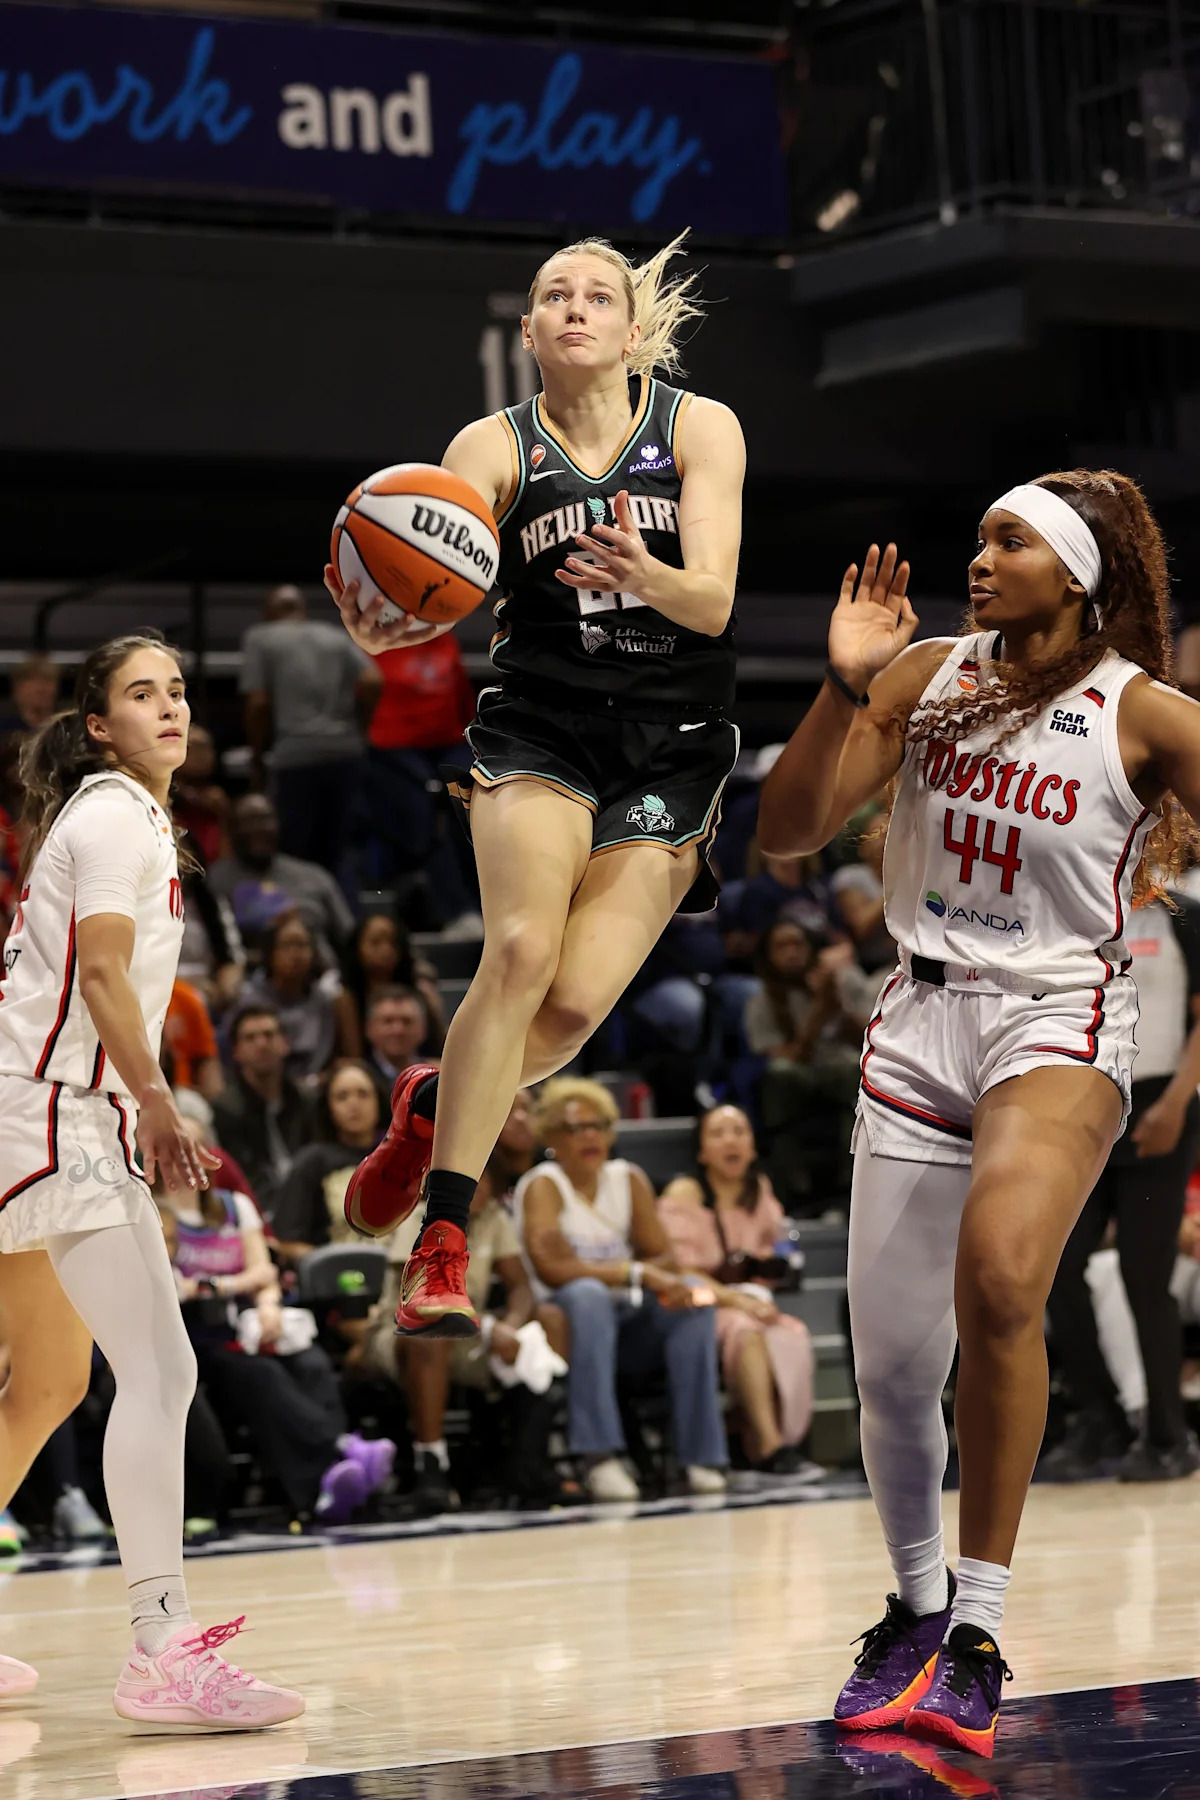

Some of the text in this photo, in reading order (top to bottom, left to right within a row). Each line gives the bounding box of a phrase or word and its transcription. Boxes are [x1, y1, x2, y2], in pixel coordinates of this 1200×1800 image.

[279, 73, 432, 157] and
[446, 52, 713, 222] play.
[629, 456, 672, 473] BARCLAYS
[411, 503, 494, 579] Wilson
[520, 501, 587, 565] NEW
[614, 638, 675, 655] Mutual
[1049, 719, 1090, 738] max
[1053, 709, 1086, 725] CAR
[943, 807, 1022, 895] 44
[946, 900, 1025, 936] VANDA
